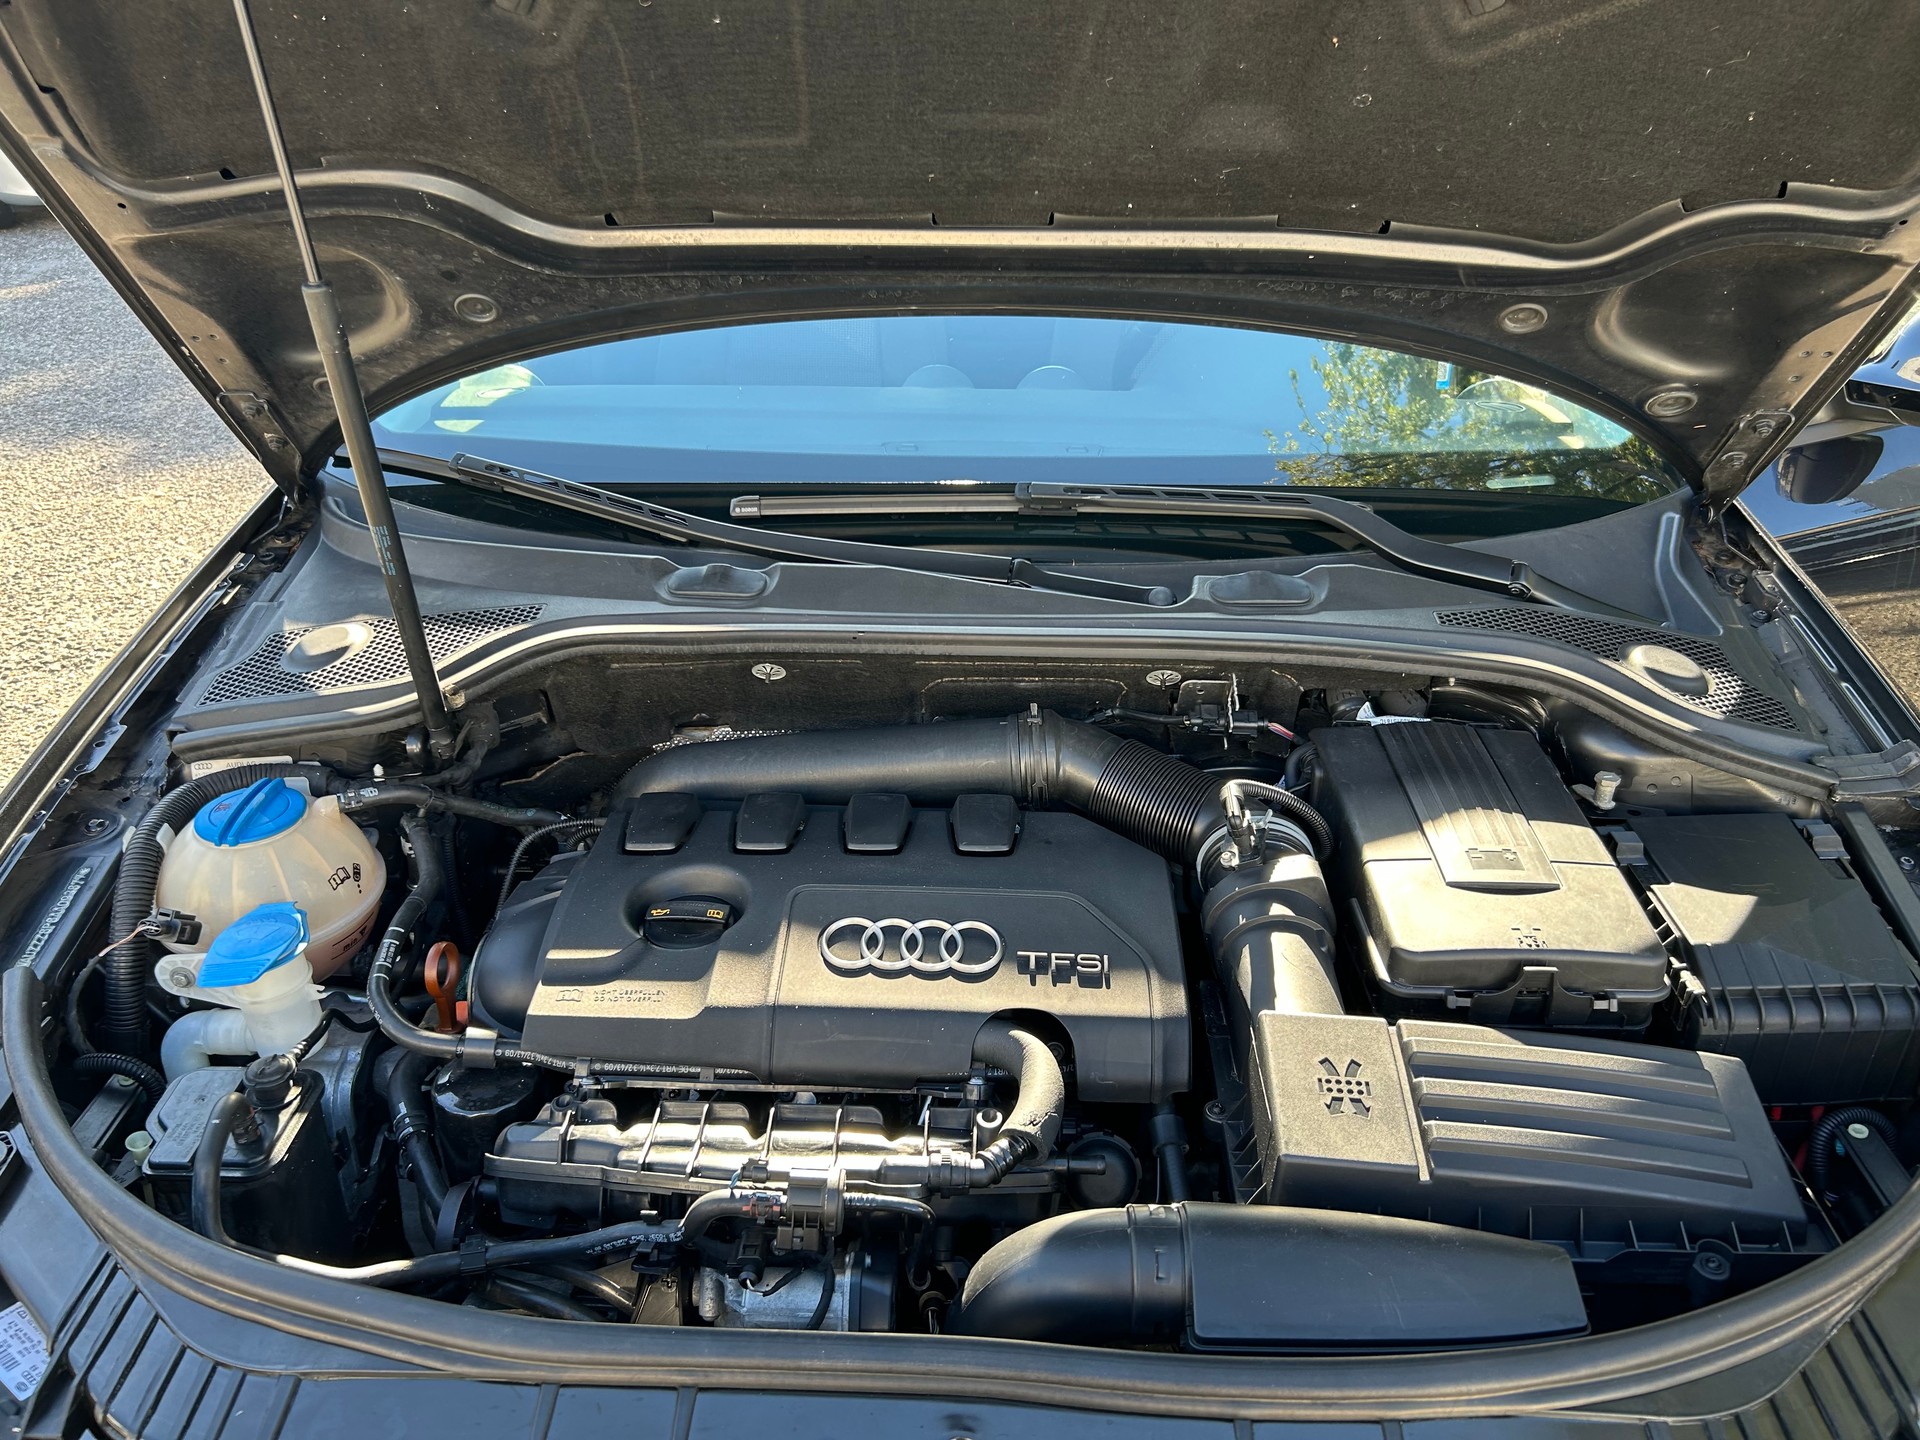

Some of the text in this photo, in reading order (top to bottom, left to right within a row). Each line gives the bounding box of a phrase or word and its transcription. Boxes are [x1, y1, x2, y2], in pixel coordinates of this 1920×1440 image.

[343, 938, 358, 951] min
[1017, 951, 1109, 972] TFSI
[662, 1065, 677, 1073] VRT
